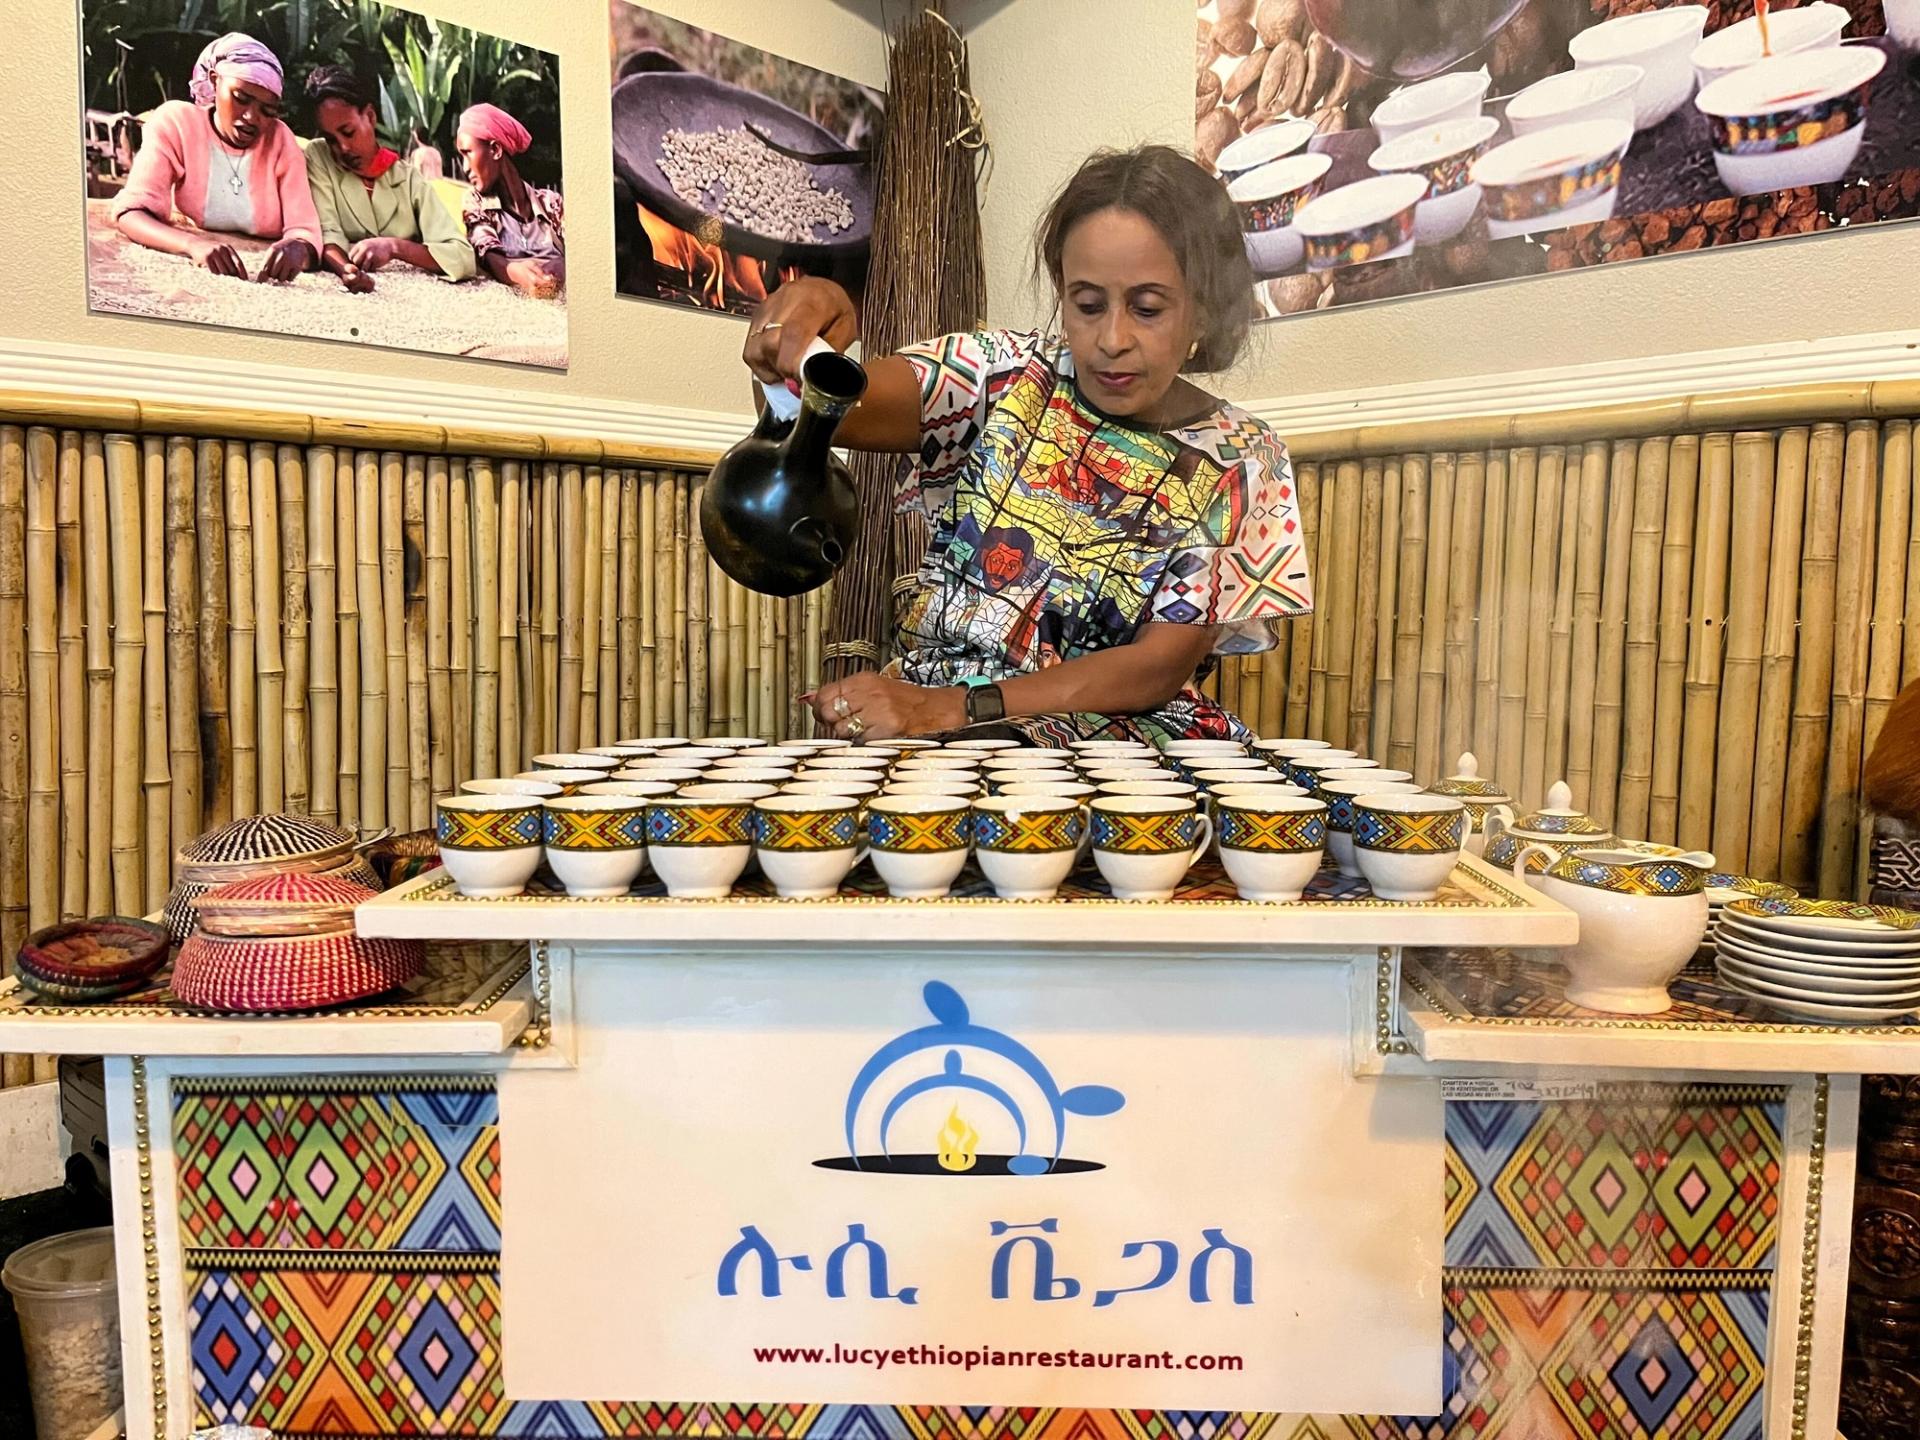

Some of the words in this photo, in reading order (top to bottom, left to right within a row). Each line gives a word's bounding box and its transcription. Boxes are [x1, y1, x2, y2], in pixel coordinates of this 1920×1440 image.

[716, 1223, 920, 1305] ሉሲ
[990, 1217, 1256, 1307] ቬጋስ
[753, 1343, 1243, 1371] www.lucyethiopianrestaurant.com
